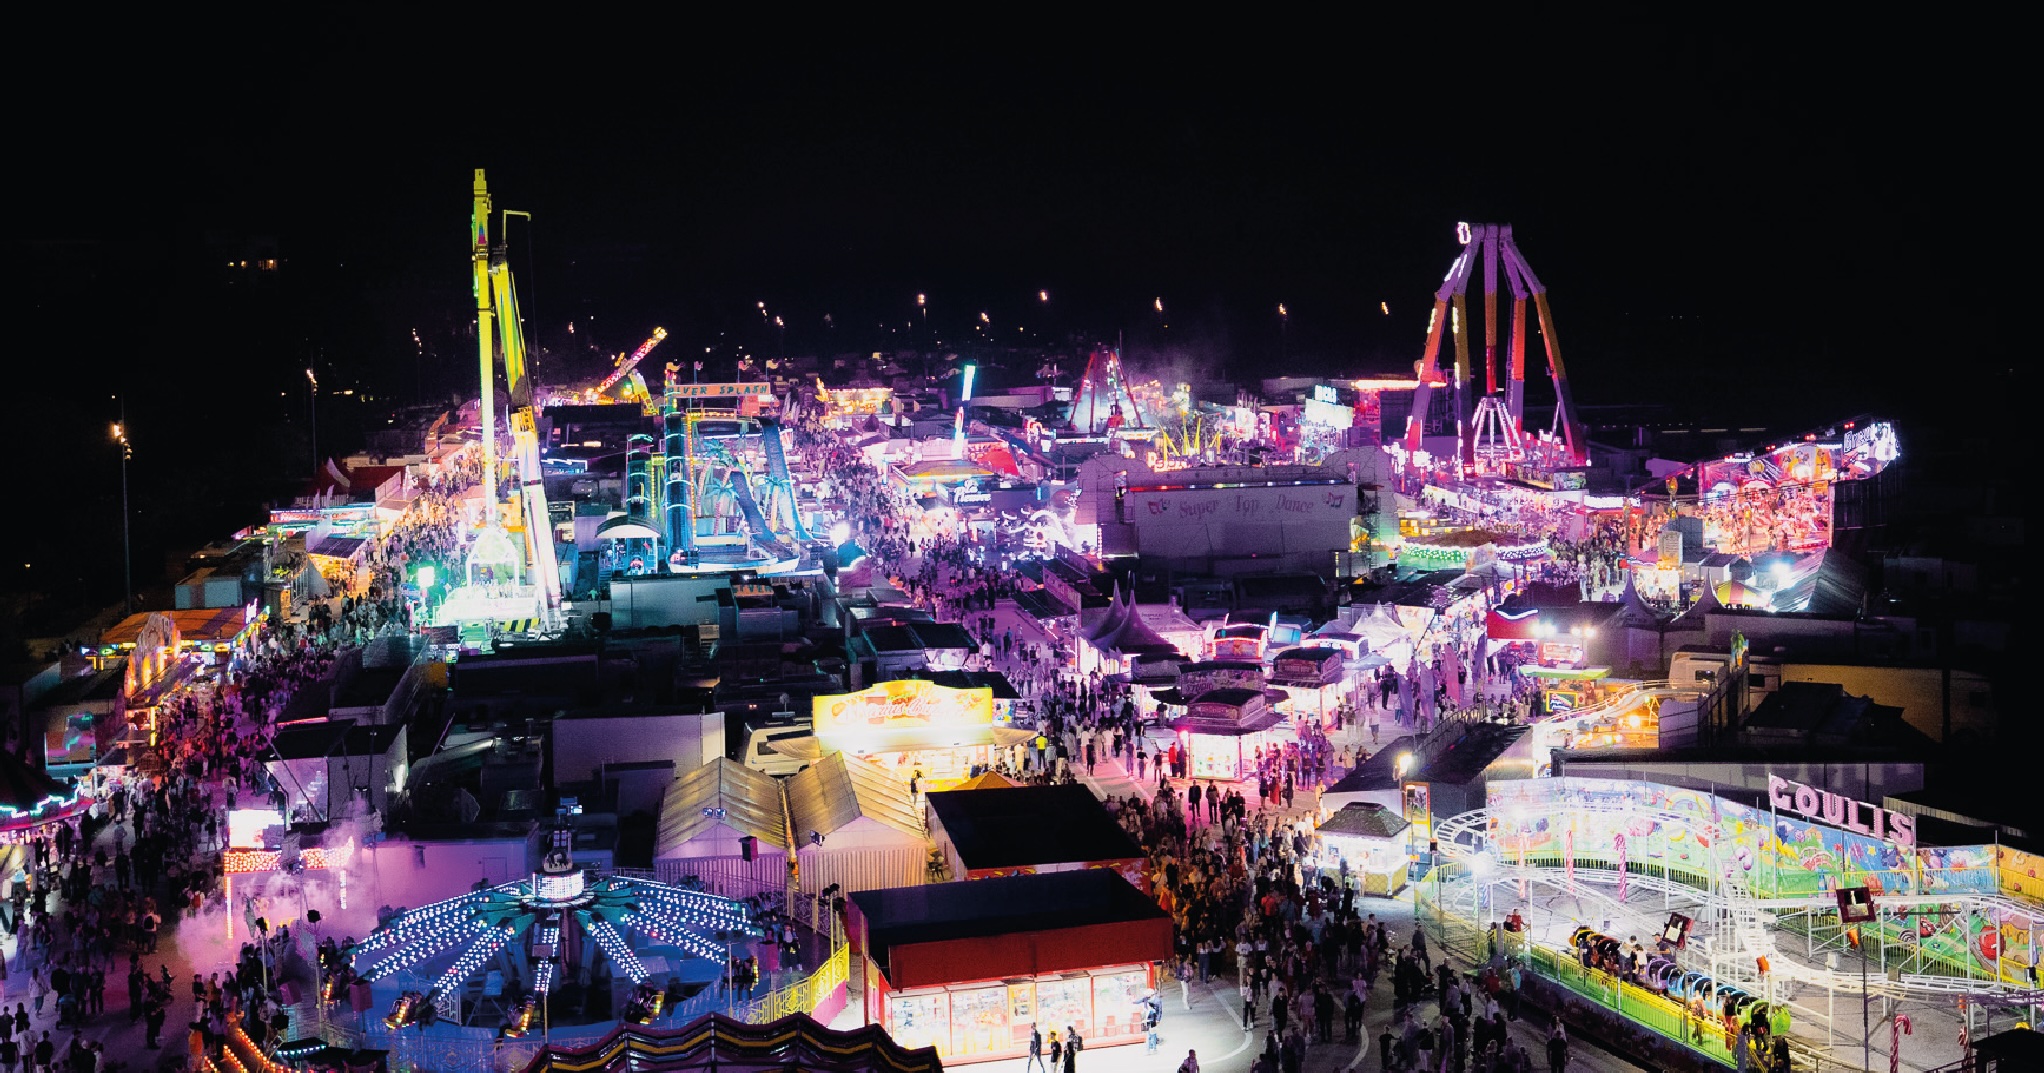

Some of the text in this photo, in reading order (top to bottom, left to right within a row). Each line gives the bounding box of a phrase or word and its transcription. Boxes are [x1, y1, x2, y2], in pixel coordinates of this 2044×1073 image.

[720, 385, 768, 394] SPLASH
[1180, 501, 1220, 519] Super
[1276, 493, 1314, 514] Dance
[1768, 776, 1914, 846] GOULIS
